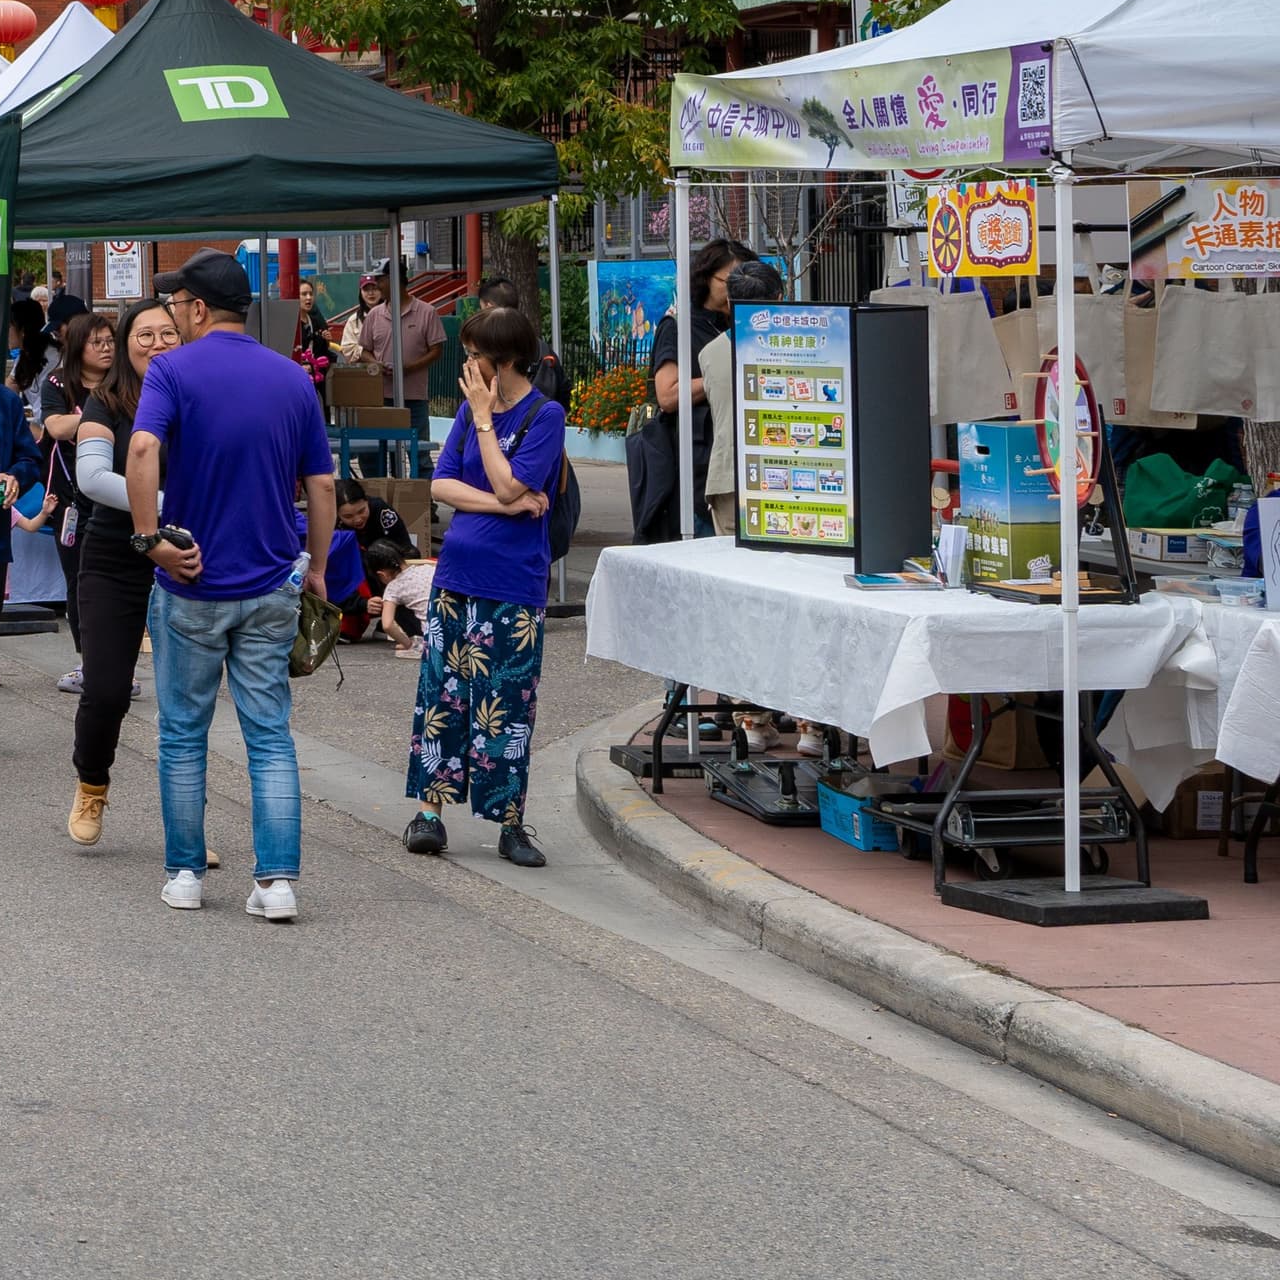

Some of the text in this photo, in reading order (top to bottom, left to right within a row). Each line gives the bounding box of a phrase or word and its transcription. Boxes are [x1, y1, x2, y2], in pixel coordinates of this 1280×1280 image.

[178, 76, 269, 110] TD
[842, 94, 909, 130] 全人關懷
[707, 101, 801, 139] 中信卡城中心
[917, 140, 940, 156] Loving
[942, 136, 990, 157] Companionship
[1212, 189, 1265, 222] 人物
[1192, 263, 1225, 272] Cartoon
[1226, 263, 1266, 272] Character
[773, 315, 829, 327] 中信卡城中心
[769, 335, 816, 348] 精神健康
[748, 379, 755, 393] 1
[748, 423, 756, 437] 2
[750, 468, 757, 482] 3
[750, 512, 758, 526] 4
